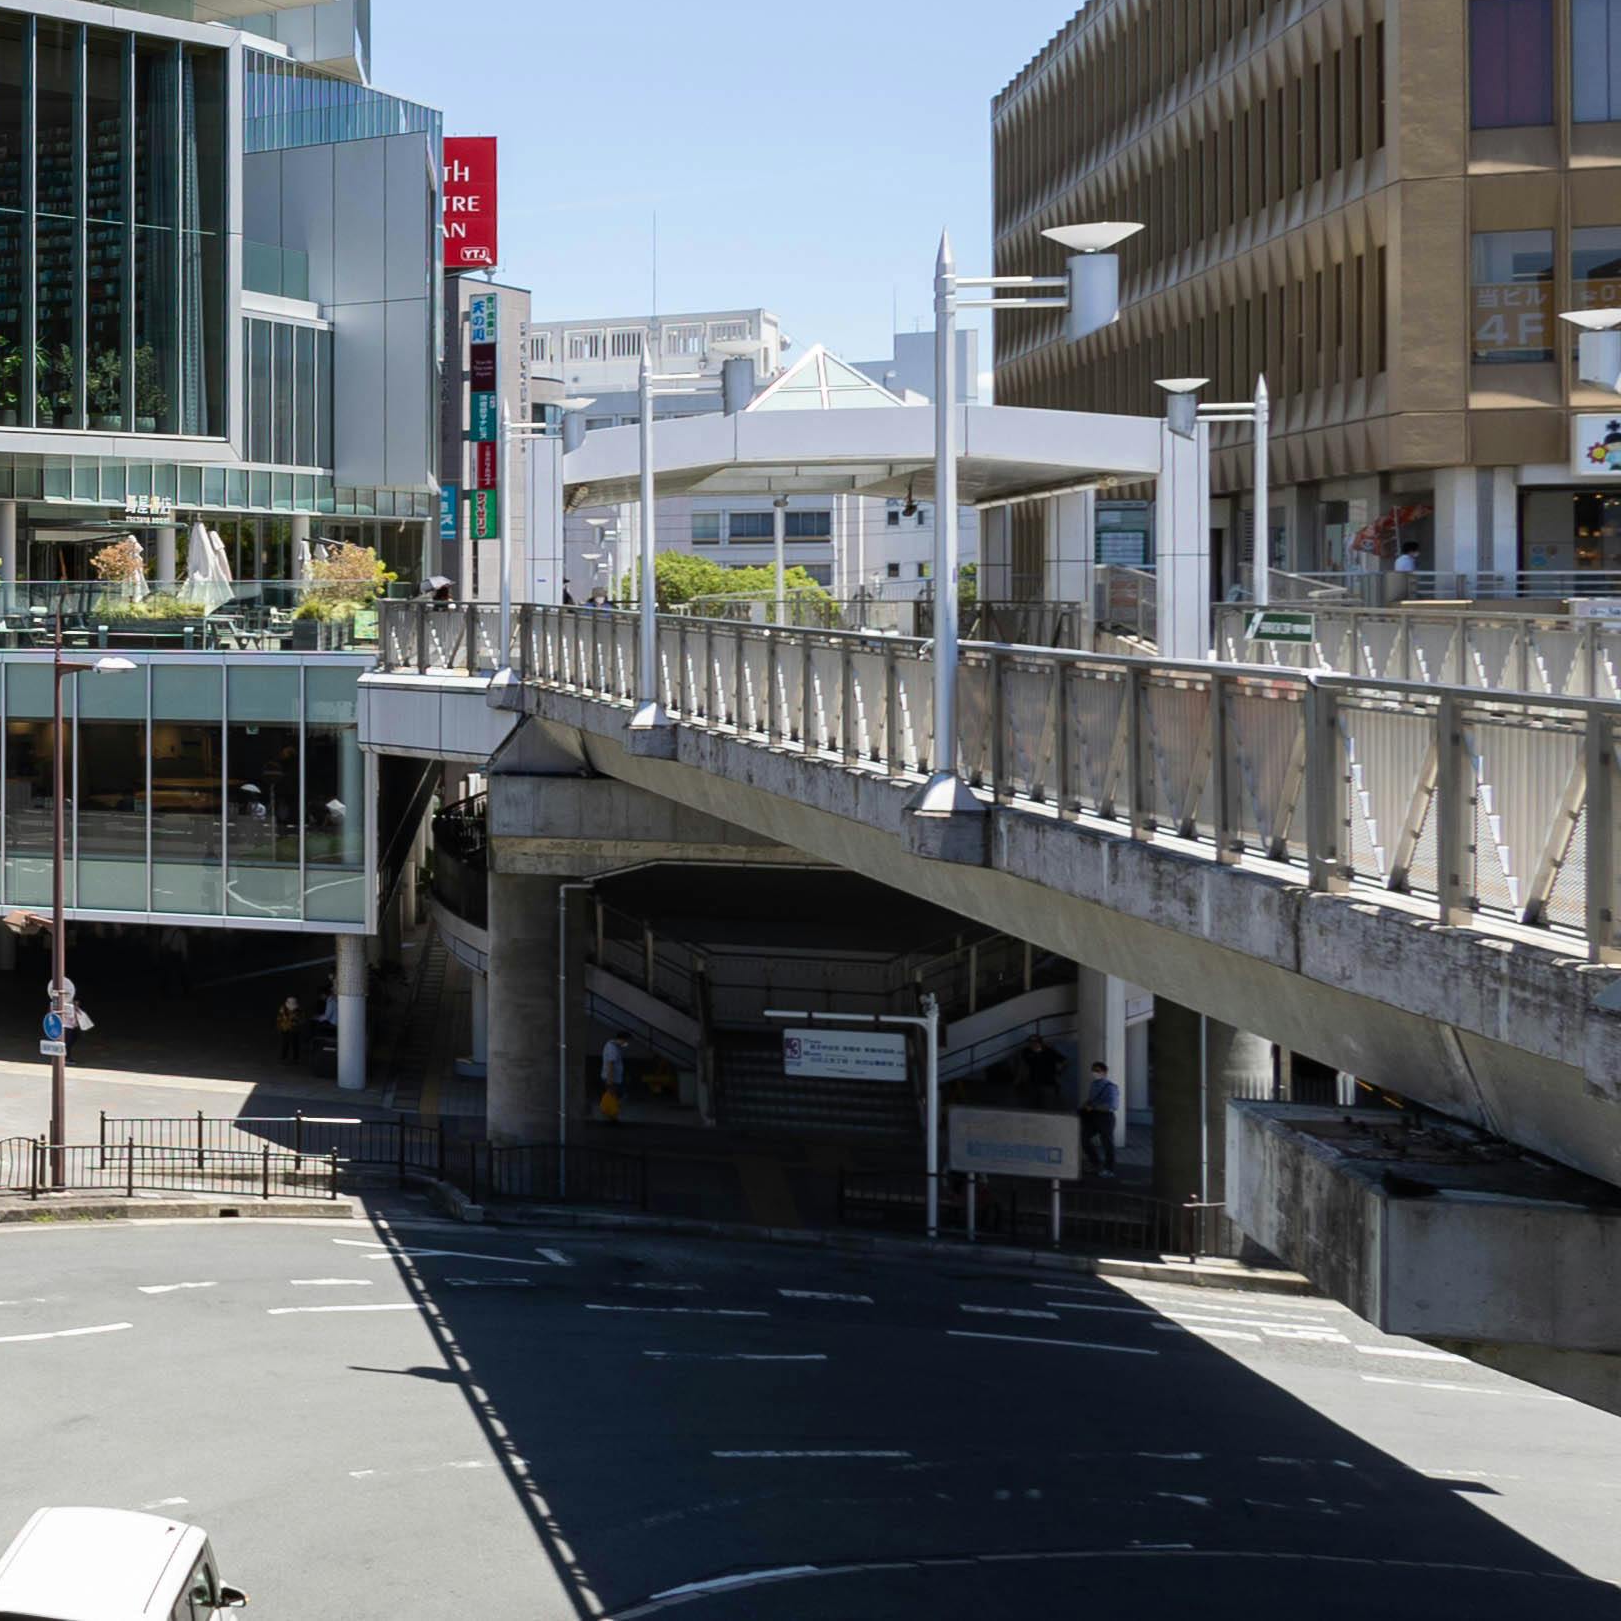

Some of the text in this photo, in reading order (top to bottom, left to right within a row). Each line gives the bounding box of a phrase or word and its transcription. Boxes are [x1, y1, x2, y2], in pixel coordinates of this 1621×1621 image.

[464, 249, 486, 259] YTJ
[1476, 287, 1548, 308] 当ビル
[1476, 312, 1544, 346] 4F
[476, 492, 487, 538] サイゼリヤ
